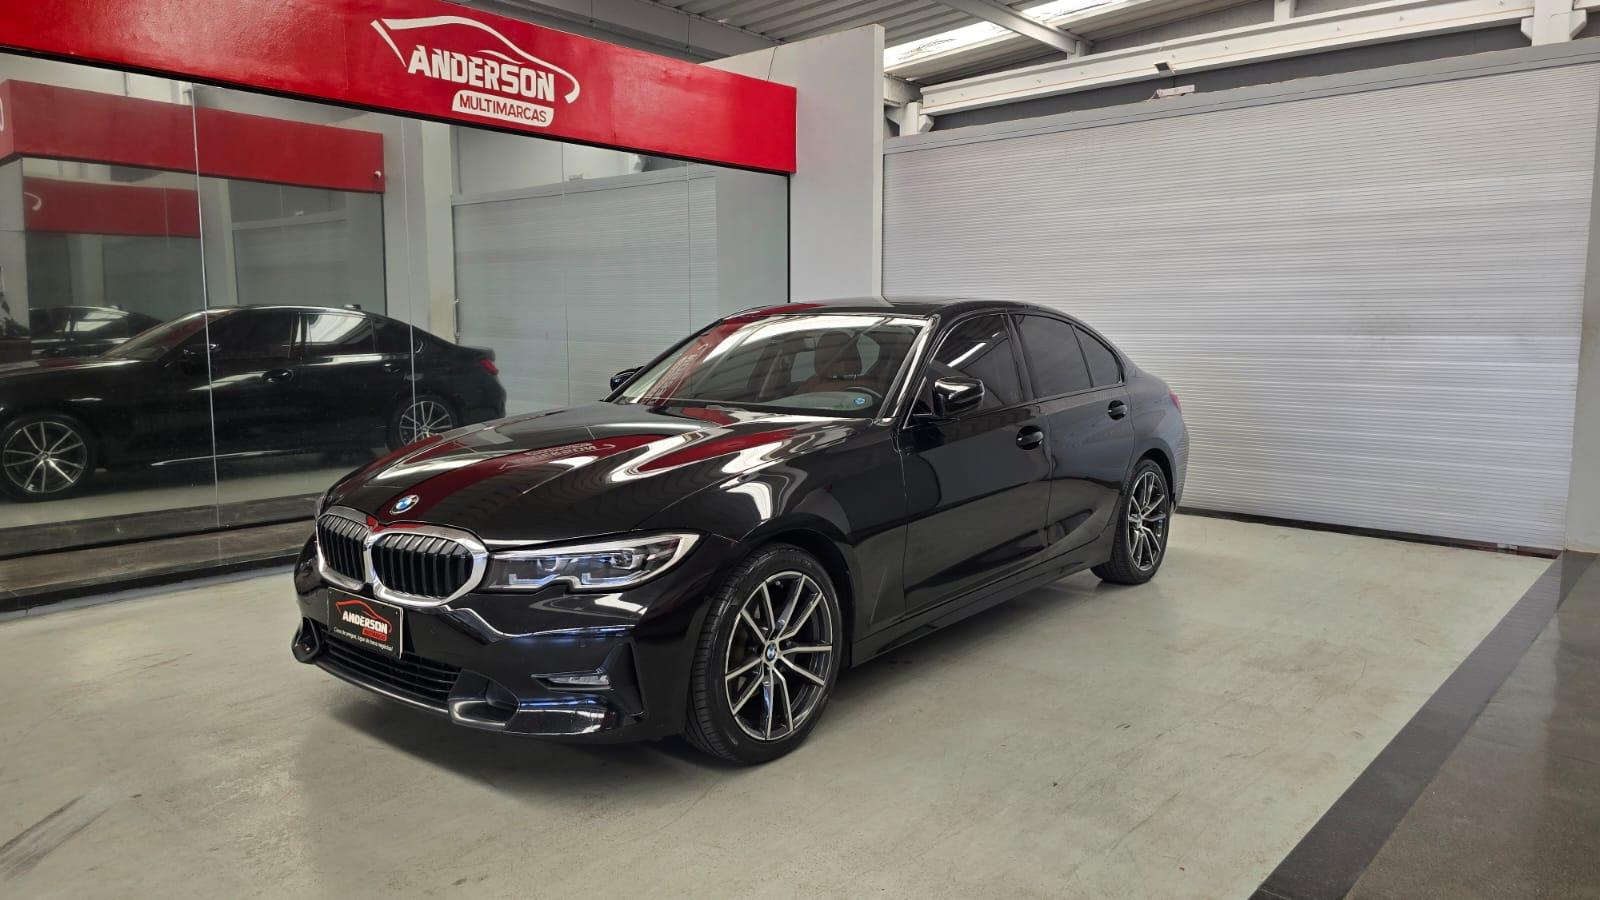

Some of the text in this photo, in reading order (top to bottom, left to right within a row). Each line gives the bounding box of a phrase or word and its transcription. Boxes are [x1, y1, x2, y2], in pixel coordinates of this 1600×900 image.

[408, 45, 555, 102] ANDERSON
[459, 94, 547, 122] MULTIMARCAS
[342, 610, 388, 634] ANDERSON
